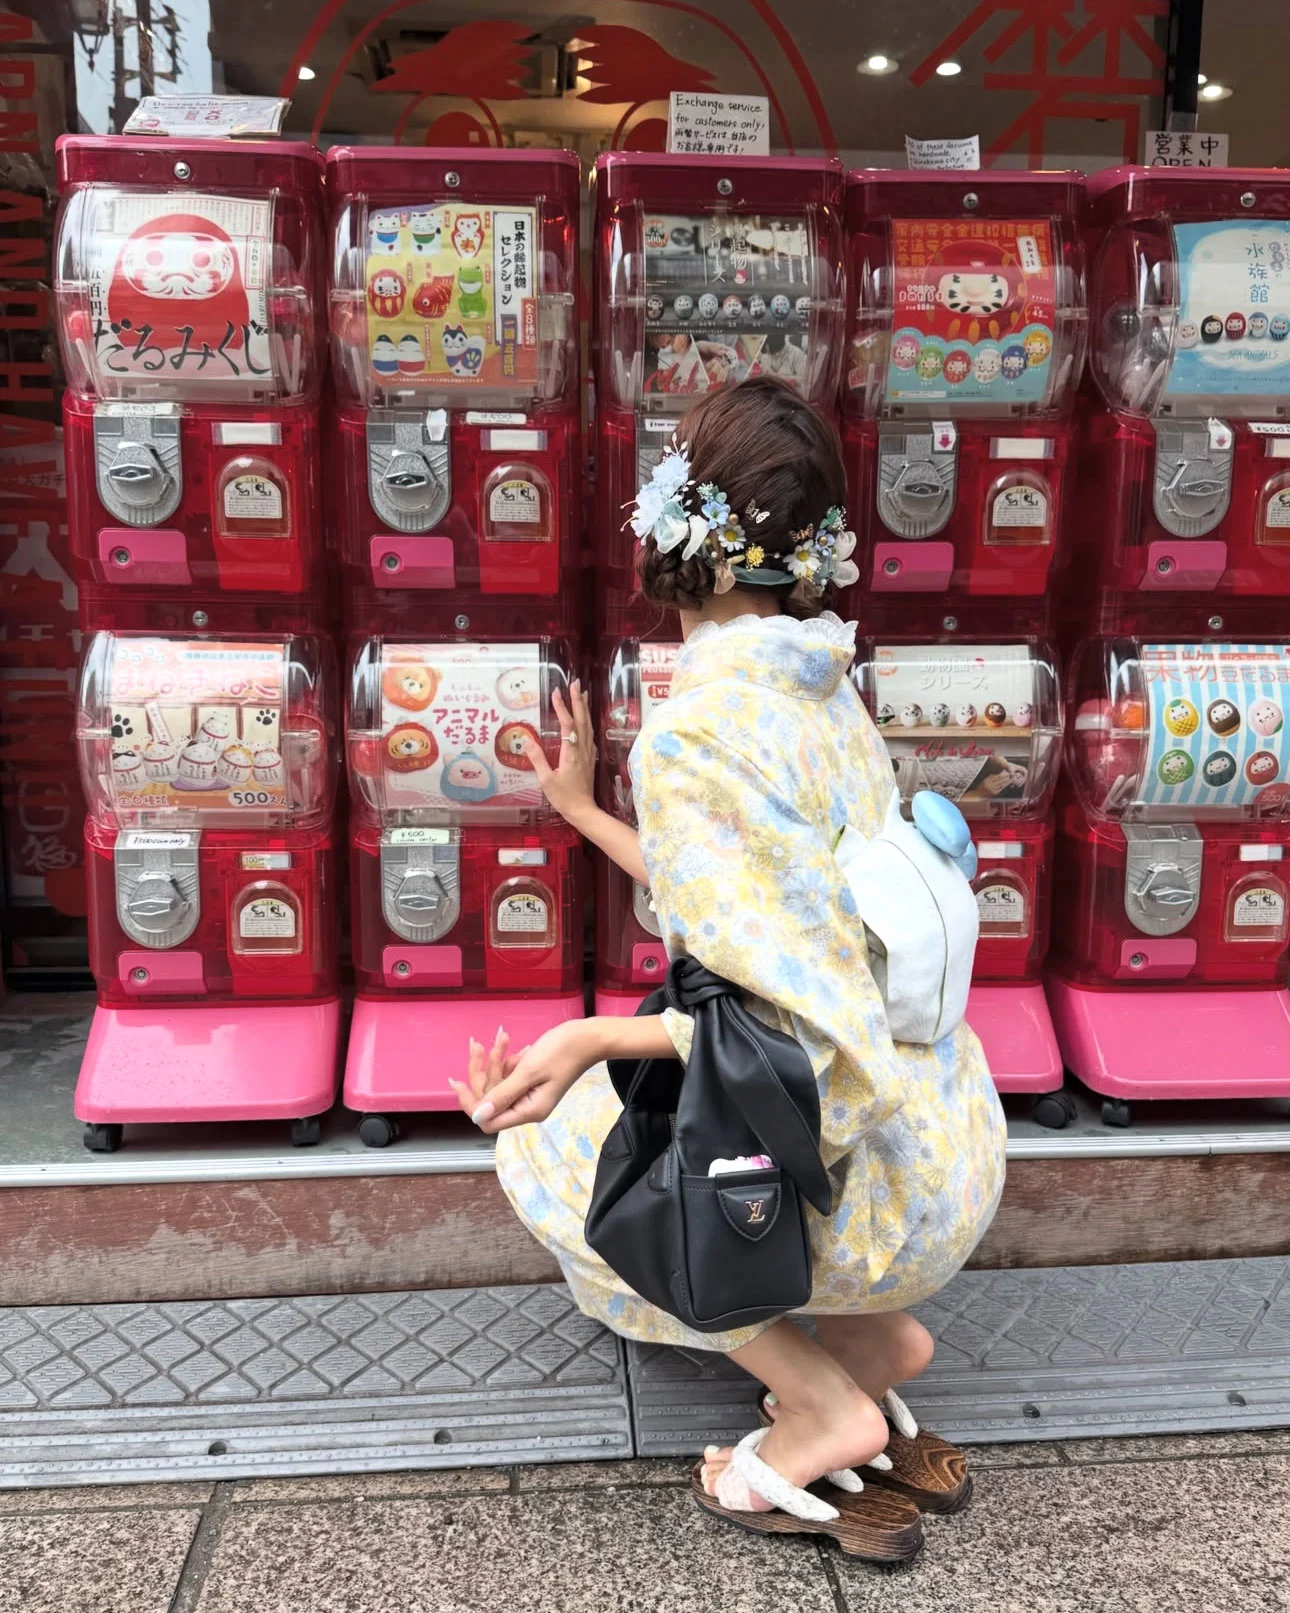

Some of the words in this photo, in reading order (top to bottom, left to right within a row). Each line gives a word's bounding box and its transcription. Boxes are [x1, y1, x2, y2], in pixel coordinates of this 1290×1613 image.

[675, 93, 724, 115] Exchange
[728, 101, 762, 113] service
[675, 112, 689, 123] for
[695, 116, 737, 127] customers
[1154, 133, 1219, 156] 営業中
[514, 220, 527, 289] 日本の縁起物
[500, 235, 513, 305] セレクション
[1245, 242, 1269, 303] 水族館
[94, 318, 271, 376] だるみくじ
[920, 675, 989, 691] シリーズ
[442, 693, 490, 702] ぬいぐるみ
[432, 708, 500, 725] アニマル
[443, 724, 489, 745] だるま
[233, 791, 287, 806] 500えん
